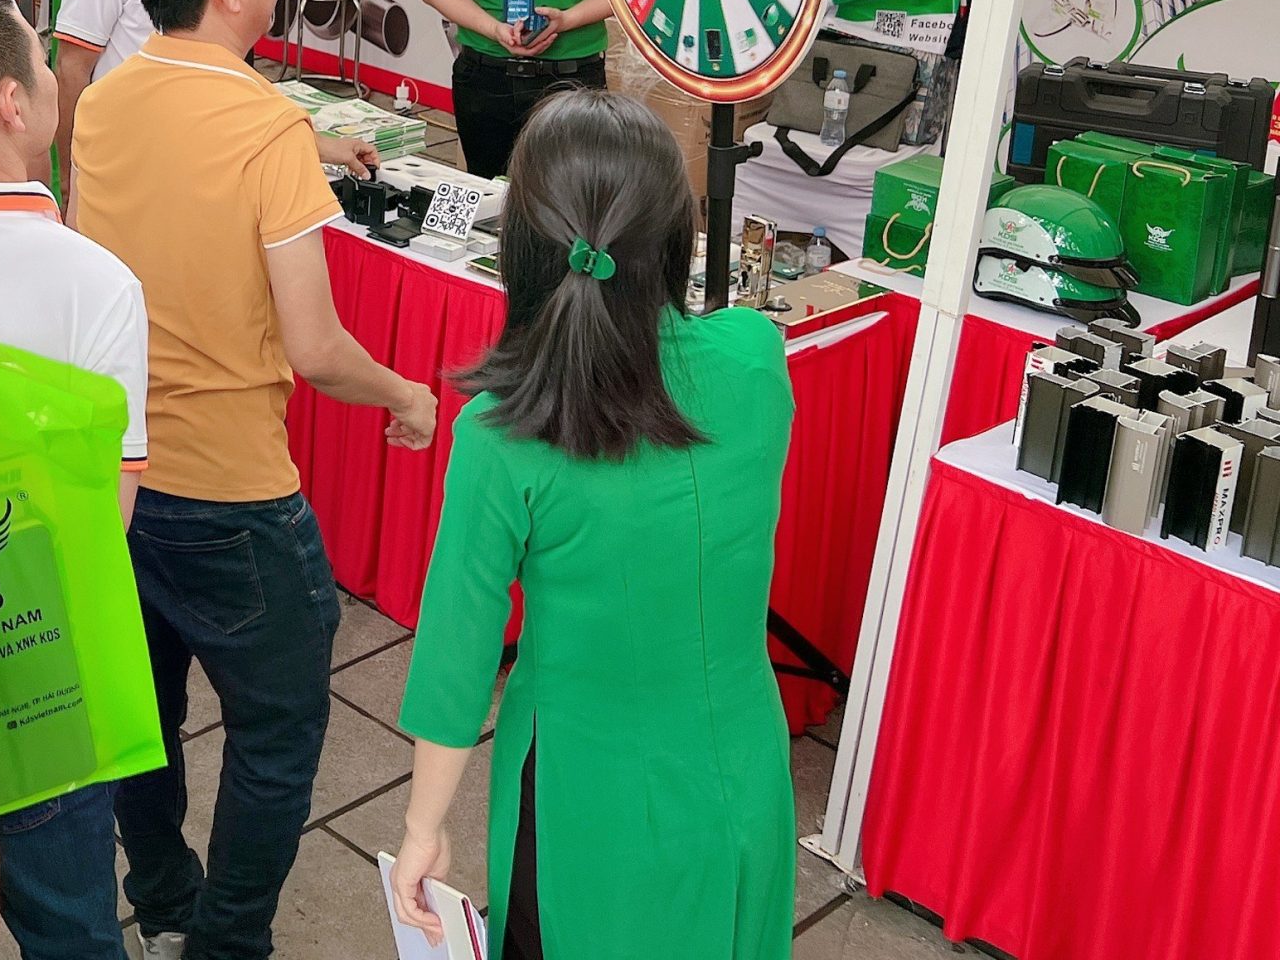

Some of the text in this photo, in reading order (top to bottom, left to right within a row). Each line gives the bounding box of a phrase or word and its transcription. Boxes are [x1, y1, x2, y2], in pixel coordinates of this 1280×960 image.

[910, 18, 954, 30] Facebo
[909, 33, 947, 44] Websit
[15, 635, 38, 653] XNK
[40, 628, 61, 644] KDS
